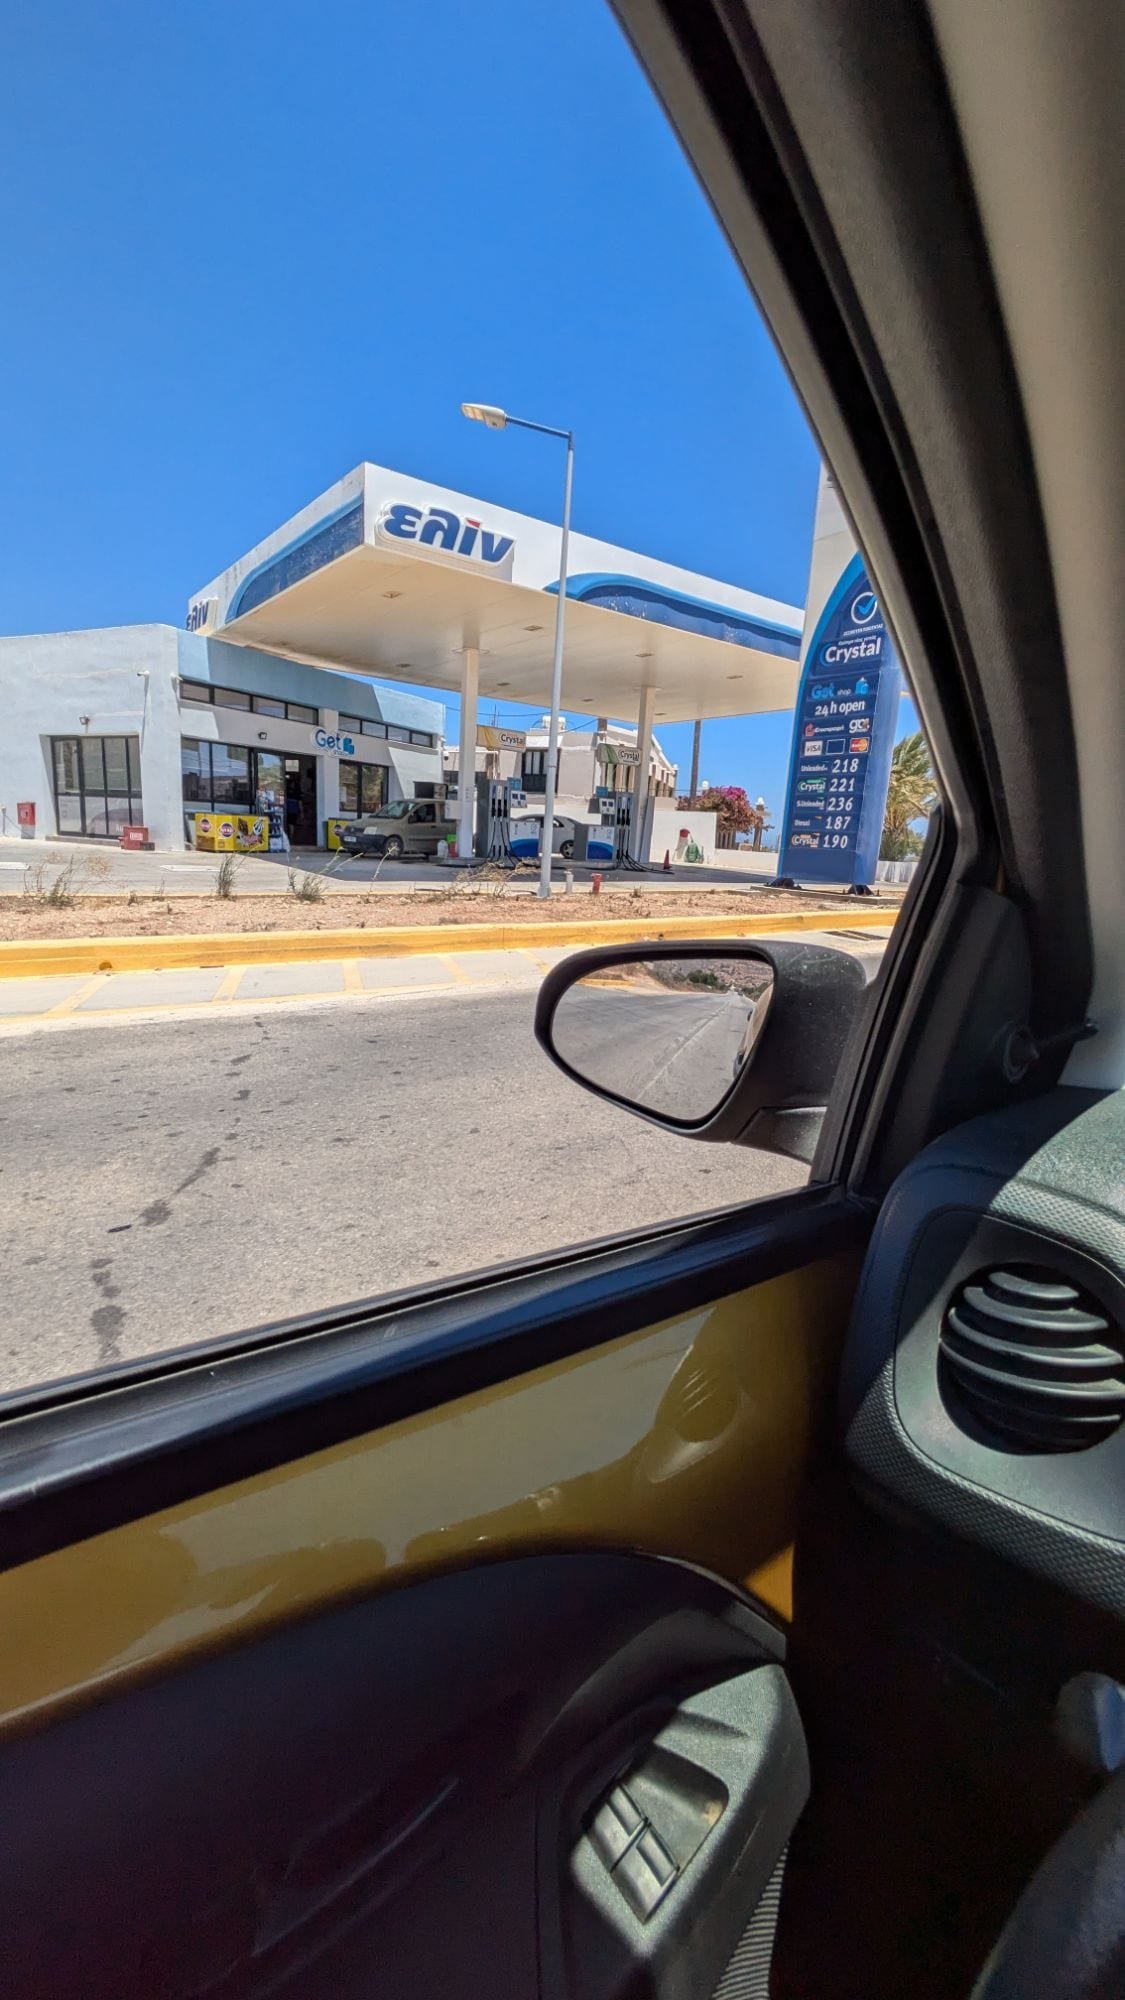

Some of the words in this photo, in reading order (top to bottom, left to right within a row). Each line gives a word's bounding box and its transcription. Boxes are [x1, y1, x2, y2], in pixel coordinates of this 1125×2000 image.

[825, 637, 881, 663] Crystal
[811, 683, 834, 699] Get
[815, 704, 829, 717] 24
[830, 700, 837, 714] h
[839, 701, 865, 715] open
[315, 729, 342, 750] Get
[806, 745, 821, 753] VISA
[832, 758, 859, 774] 218
[800, 781, 825, 791] Crystal
[829, 778, 855, 792] 221
[827, 797, 853, 811] 236
[825, 816, 851, 830] 187
[794, 835, 819, 845] Crystal
[823, 835, 848, 848] 190
